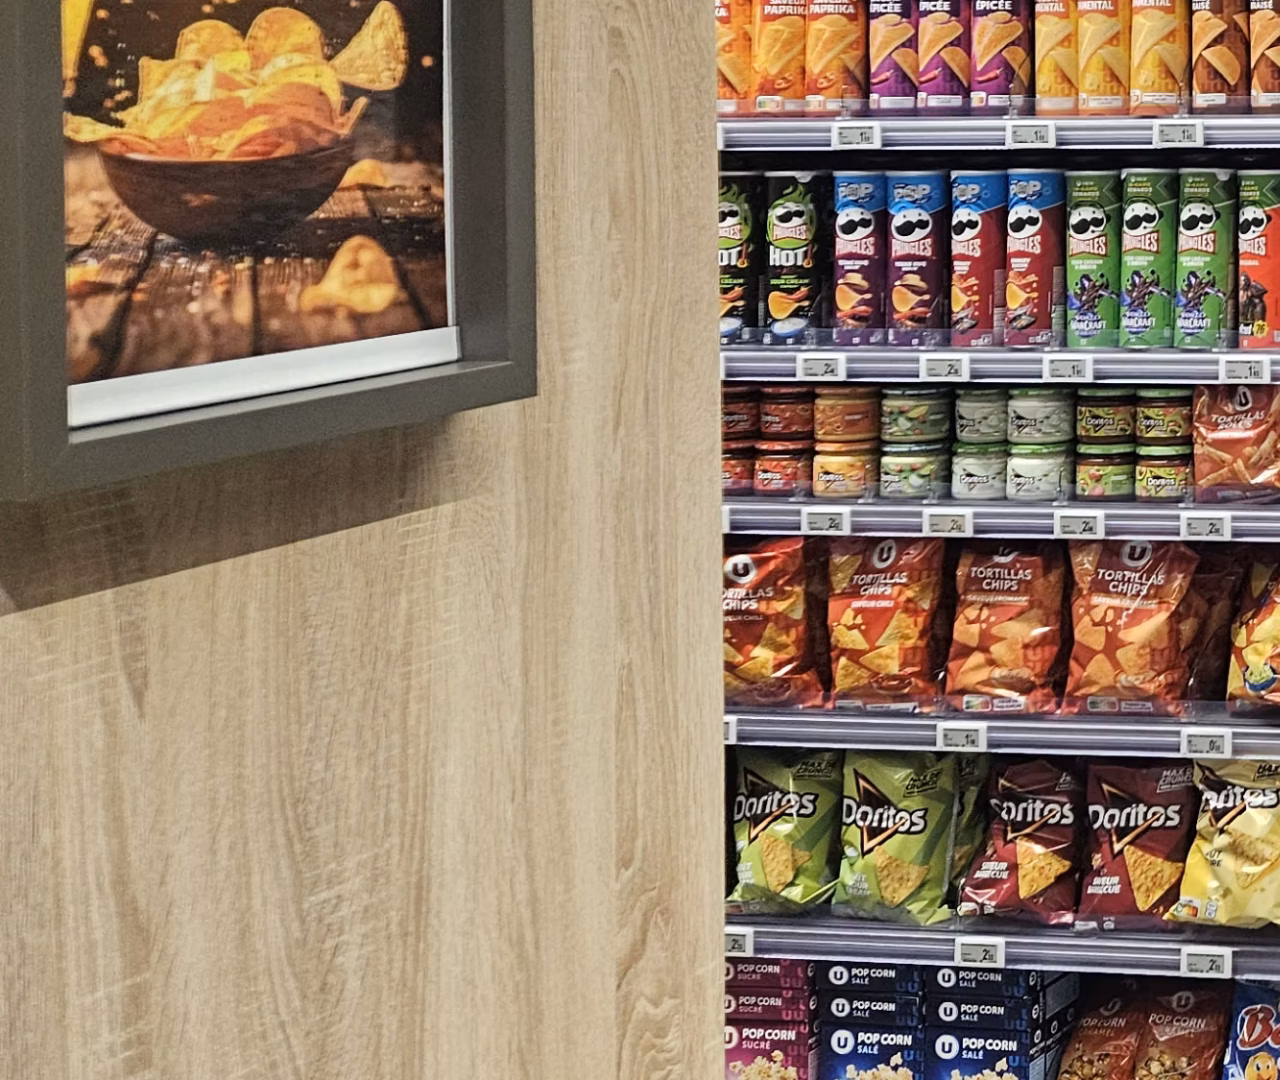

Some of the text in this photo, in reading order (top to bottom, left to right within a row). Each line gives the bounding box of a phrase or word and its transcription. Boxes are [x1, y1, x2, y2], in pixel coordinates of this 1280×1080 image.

[809, 4, 855, 15] PAPRIKA
[835, 237, 876, 256] PRINGLES
[891, 237, 933, 257] PRINGLES
[1068, 235, 1107, 257] PRINGLES
[1122, 232, 1159, 253] PRINGLES
[1178, 232, 1216, 253] PRINGLES
[1211, 410, 1265, 423] TORTILLAS
[852, 572, 908, 587] TORTILLAS
[970, 567, 1032, 580] TORTILLAS
[1097, 568, 1165, 586] TORTILLAS
[859, 584, 893, 596] CHIPS
[982, 578, 1019, 591] CHIPS
[1109, 581, 1149, 596] CHIPS
[722, 587, 774, 599] ORTILLAS
[733, 792, 816, 821] Doritos
[842, 796, 926, 832] Doritos
[1087, 804, 1181, 830] Doritos
[737, 963, 780, 974] POP CORN
[851, 968, 869, 978] POP
[870, 968, 896, 979] CORN
[851, 975, 870, 985] SALÉ
[959, 971, 1002, 982] POP CORN
[959, 979, 977, 989] SALÉ
[738, 996, 782, 1007] POP CORN
[852, 1000, 896, 1012] POP CORN
[852, 1008, 869, 1018] SALÉ
[1150, 1013, 1206, 1029] POP CORN
[741, 1028, 796, 1042] POP CORN
[857, 1032, 880, 1045] POP
[880, 1034, 912, 1047] CORN
[741, 1039, 771, 1050] SUCRÉ
[857, 1042, 879, 1055] SALÉ
[962, 1037, 1017, 1053] POP CORN
[962, 1048, 984, 1060] SALÉ
